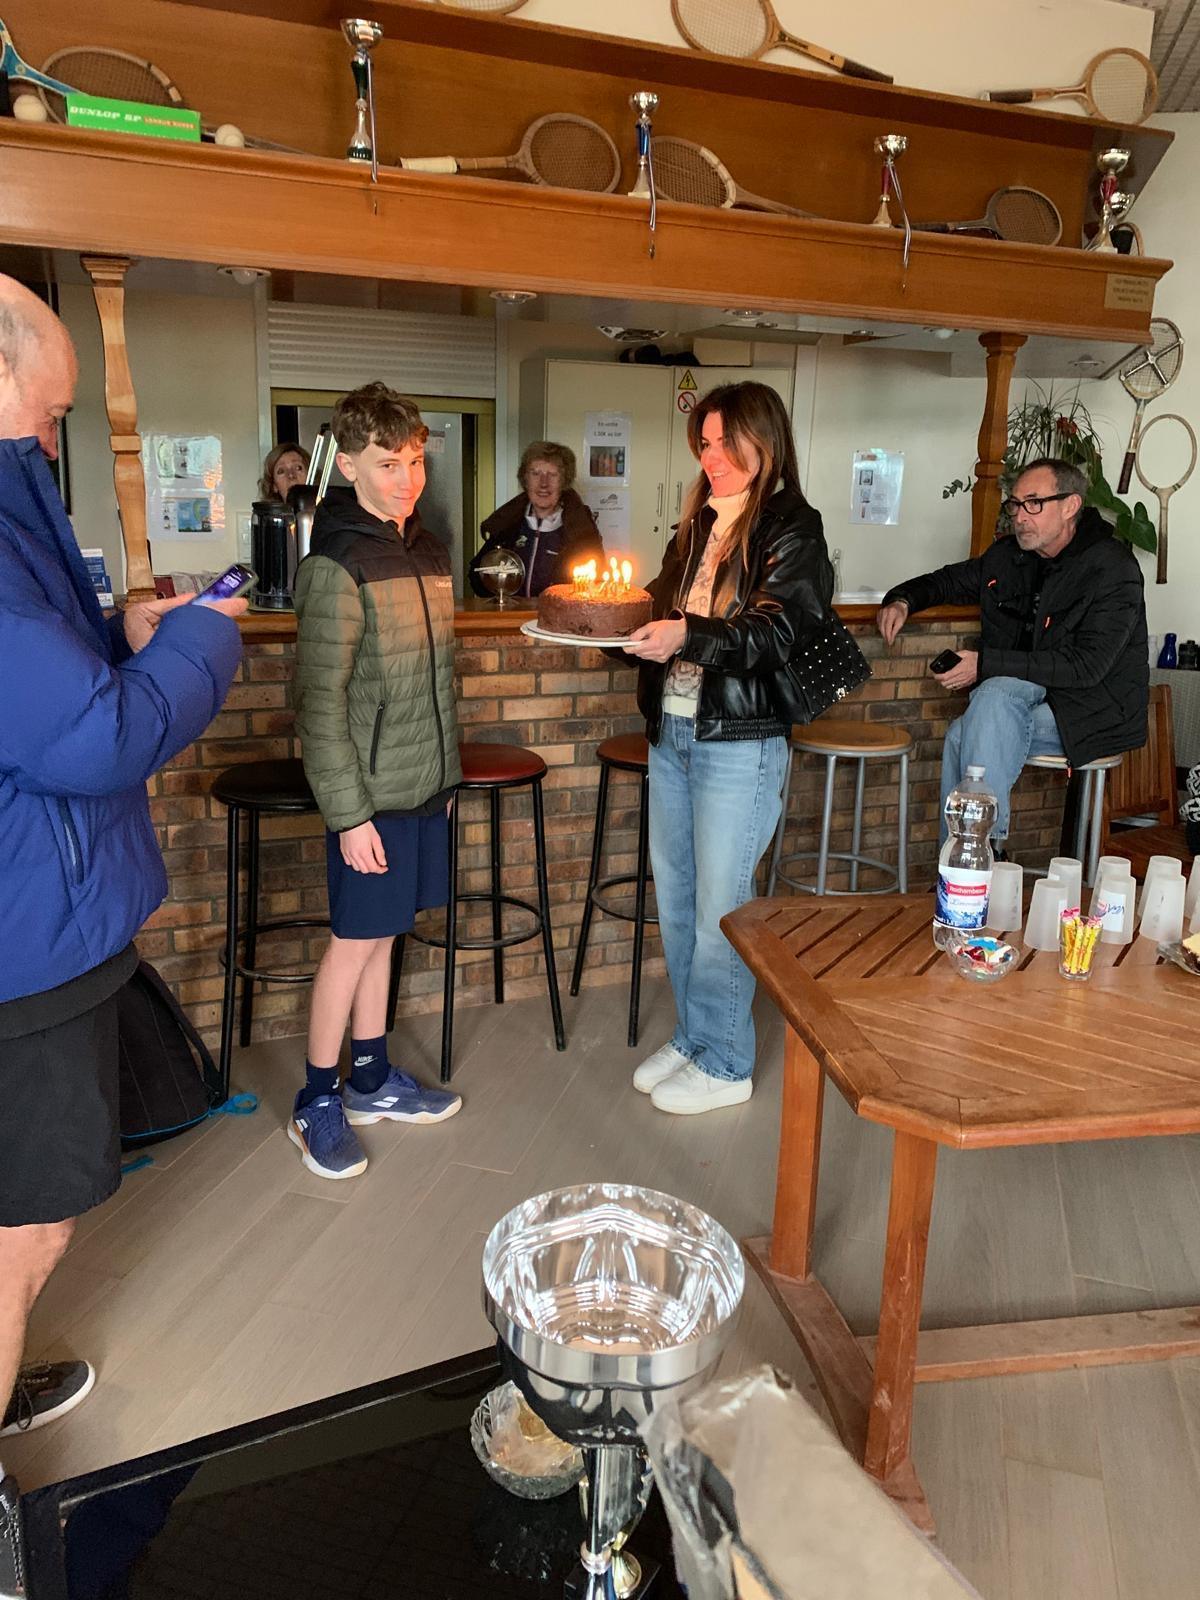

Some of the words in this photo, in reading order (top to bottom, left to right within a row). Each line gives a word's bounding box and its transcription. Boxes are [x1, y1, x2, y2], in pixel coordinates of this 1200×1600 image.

[69, 105, 121, 119] DUNLOP
[124, 113, 142, 122] SP
[357, 1054, 373, 1062] NIKE
